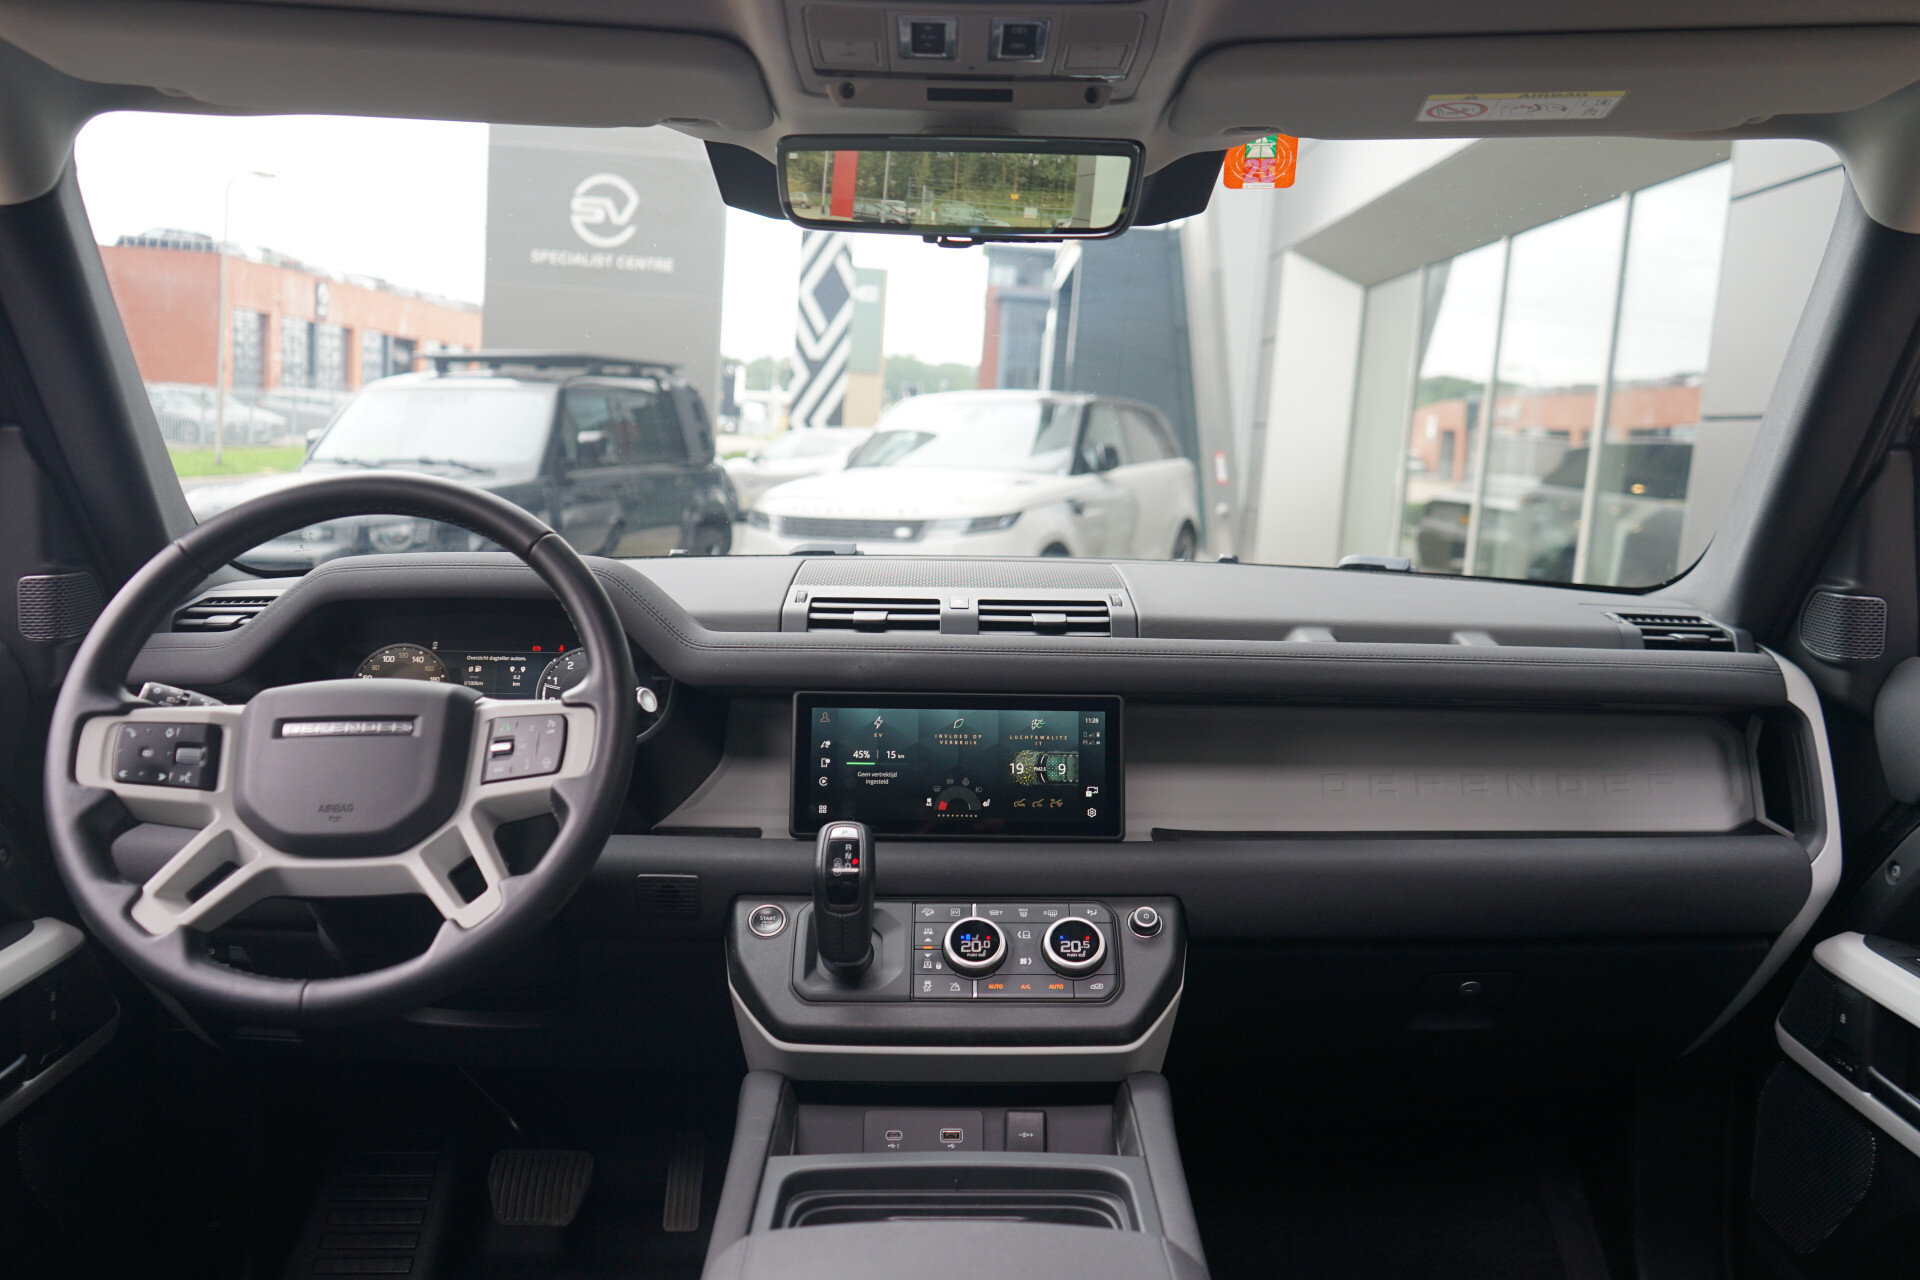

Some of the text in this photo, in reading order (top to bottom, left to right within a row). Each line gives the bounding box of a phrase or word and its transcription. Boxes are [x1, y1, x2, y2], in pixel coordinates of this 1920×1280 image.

[530, 248, 675, 274] SPECIALIST CENTRE
[382, 655, 395, 663] 100
[567, 661, 574, 670] 2
[553, 676, 558, 685] 1
[852, 750, 871, 759] 45%
[886, 750, 896, 759] 15
[1009, 762, 1024, 775] 19
[1058, 763, 1066, 775] 9
[1320, 773, 1675, 799] DEFENDER
[317, 804, 355, 814] AIRBAG
[960, 940, 990, 953] 20.0
[1060, 940, 1090, 953] 20.5
